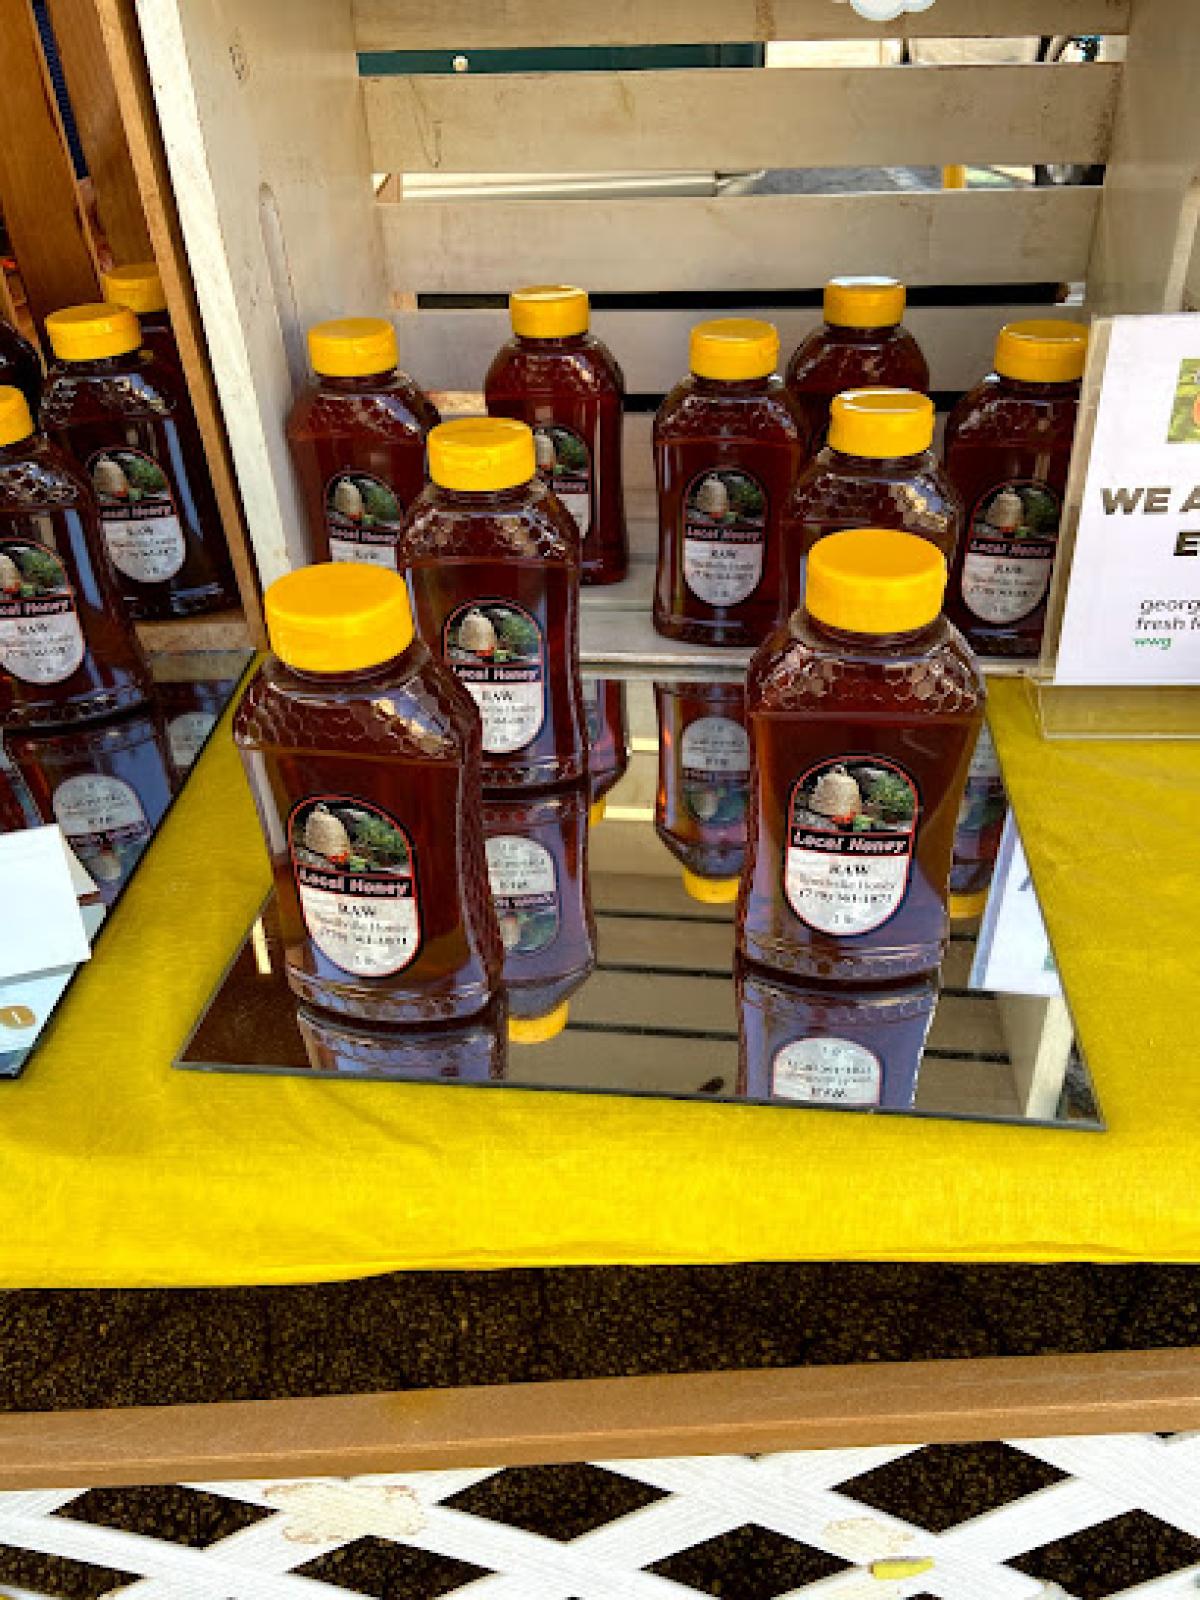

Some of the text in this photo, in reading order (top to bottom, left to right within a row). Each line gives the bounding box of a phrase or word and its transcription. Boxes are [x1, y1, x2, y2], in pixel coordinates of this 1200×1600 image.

[1100, 487, 1171, 515] WE
[1136, 617, 1186, 631] fresh
[793, 830, 907, 854] Local Honey
[828, 864, 871, 875] RAW
[299, 867, 410, 898] Local Honey
[337, 902, 378, 916] RAW
